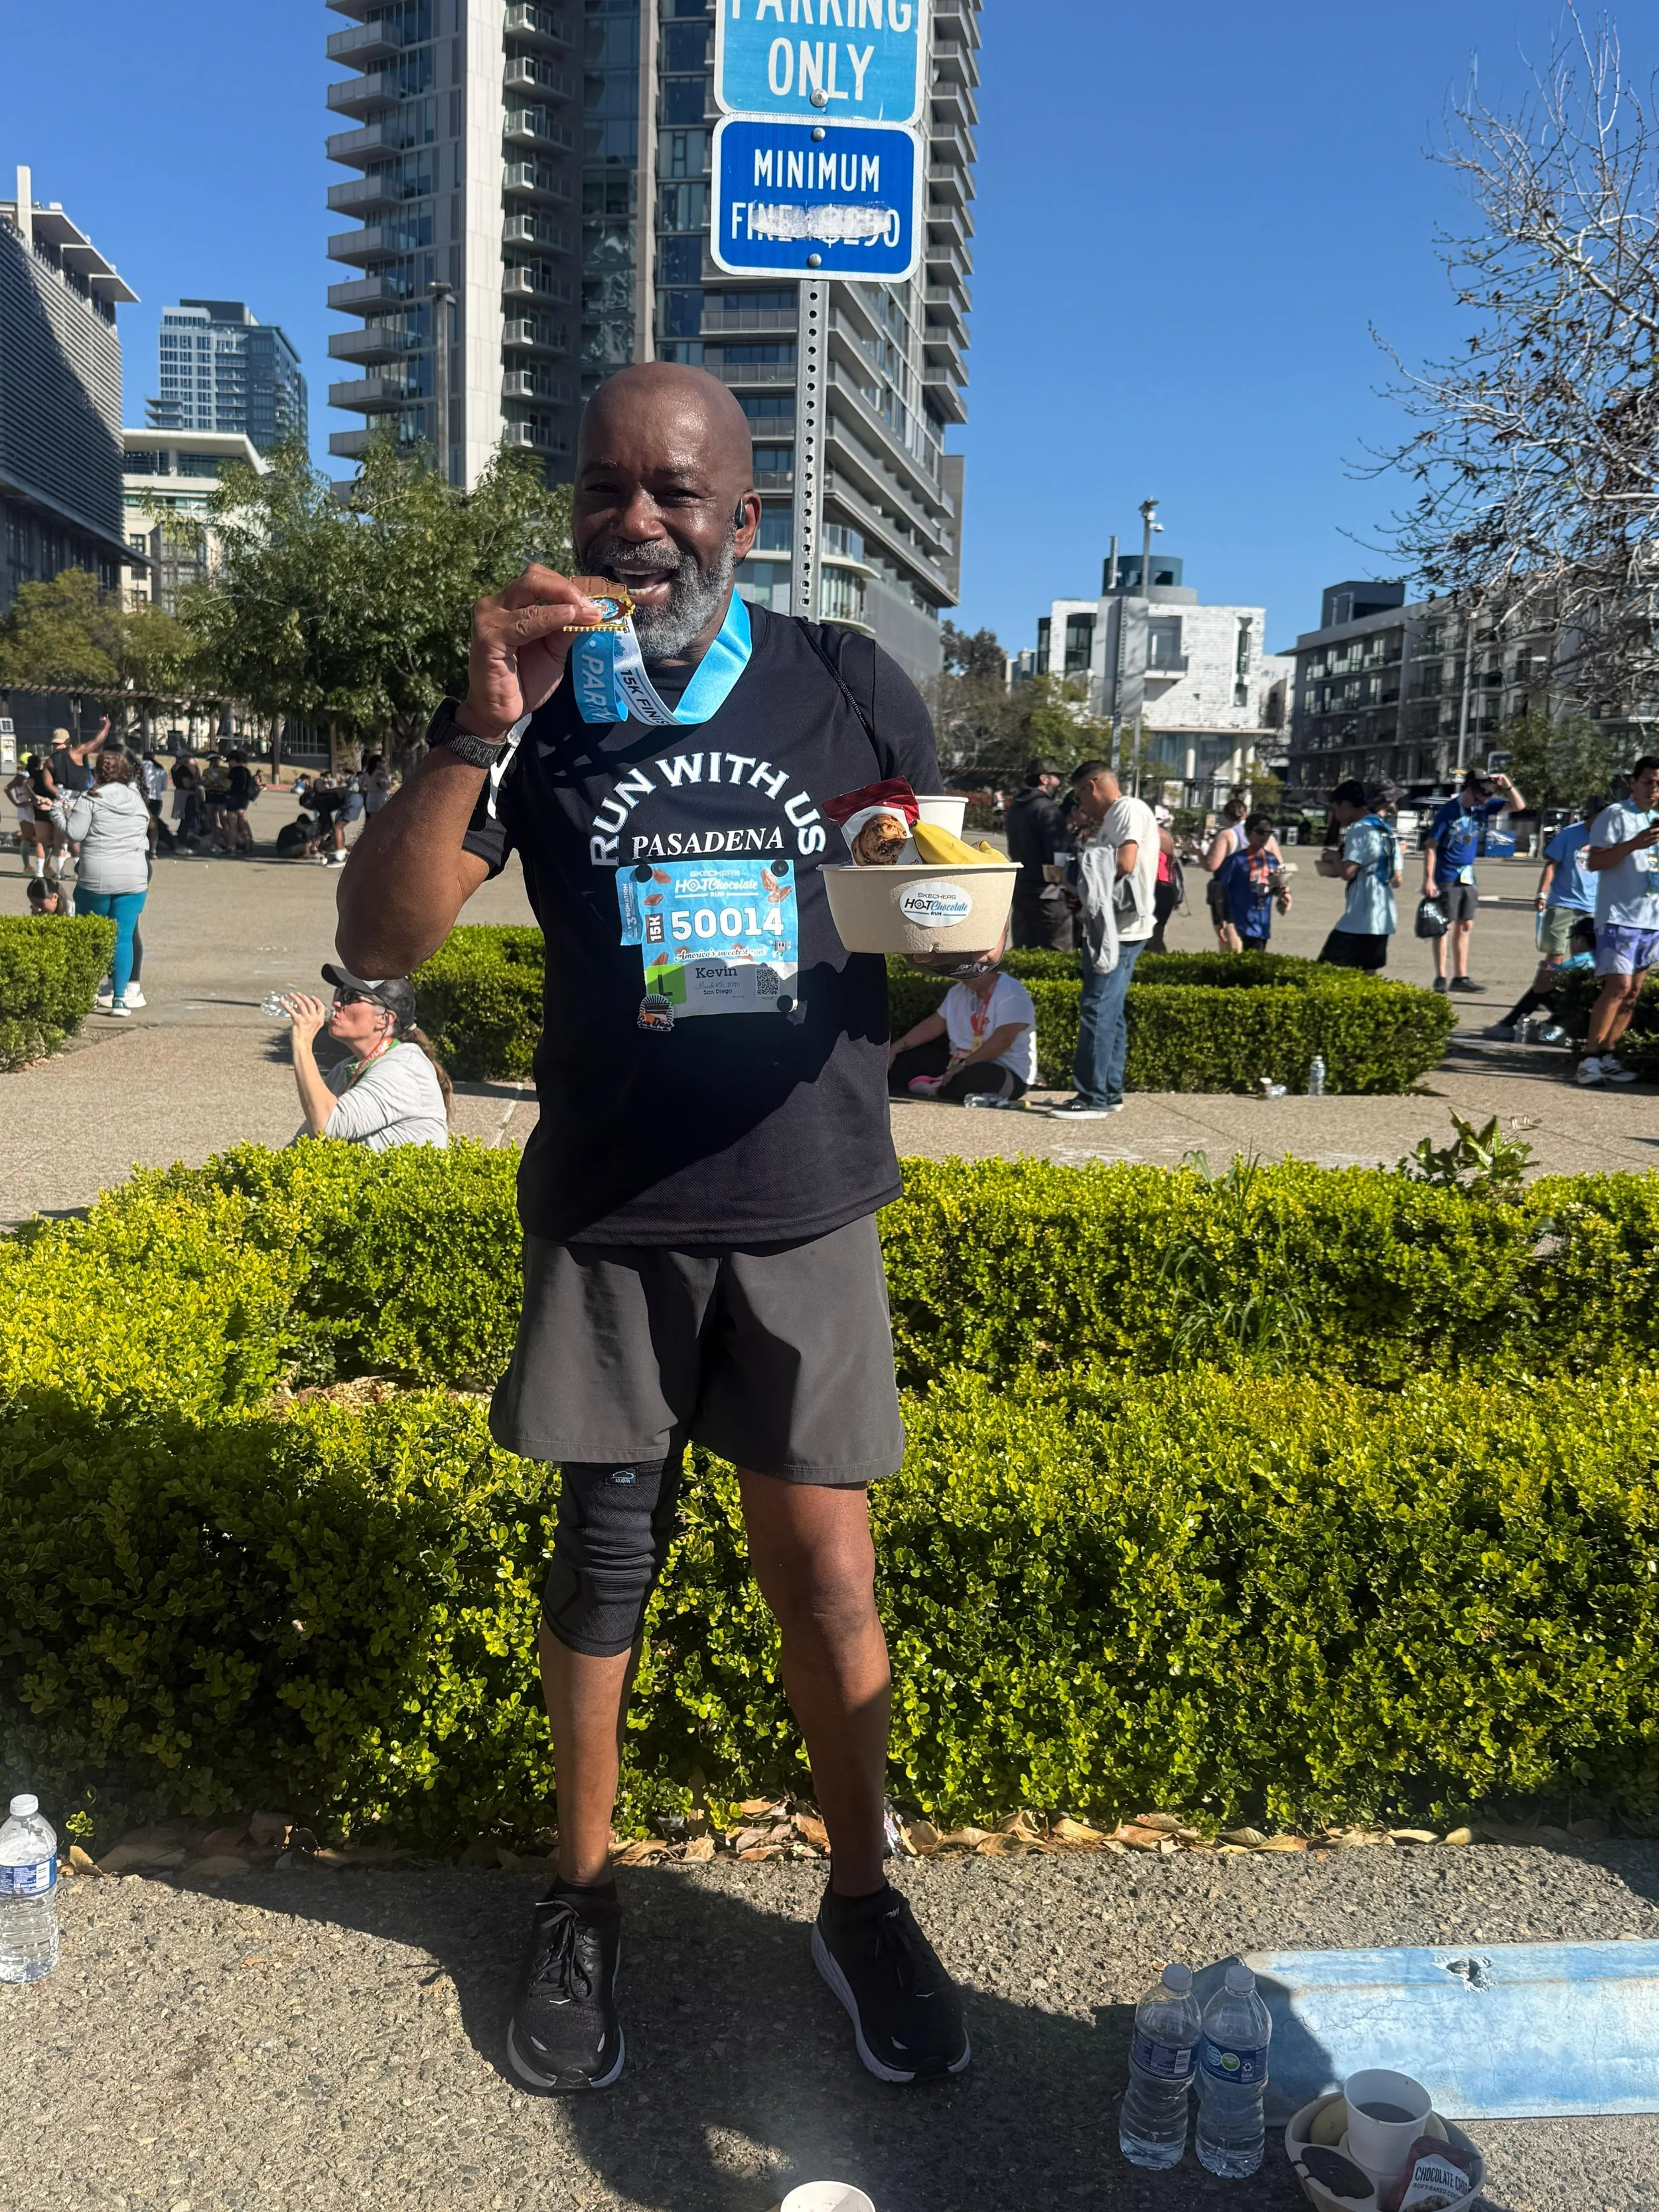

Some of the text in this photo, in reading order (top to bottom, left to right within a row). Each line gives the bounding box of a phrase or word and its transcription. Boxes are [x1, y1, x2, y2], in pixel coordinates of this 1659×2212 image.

[768, 37, 875, 101] ONLY
[753, 149, 880, 192] MINIMUM
[620, 669, 643, 695] 15K
[589, 751, 826, 867] RUN WITH US
[631, 826, 784, 860] PASADENA
[904, 898, 934, 910] HOT
[649, 915, 662, 942] 15K
[671, 907, 784, 940] 50014
[695, 966, 738, 979] Kevin
[1412, 2182, 1447, 2195] SOFT-BAKED
[1414, 2166, 1454, 2188] CHOCOLATE
